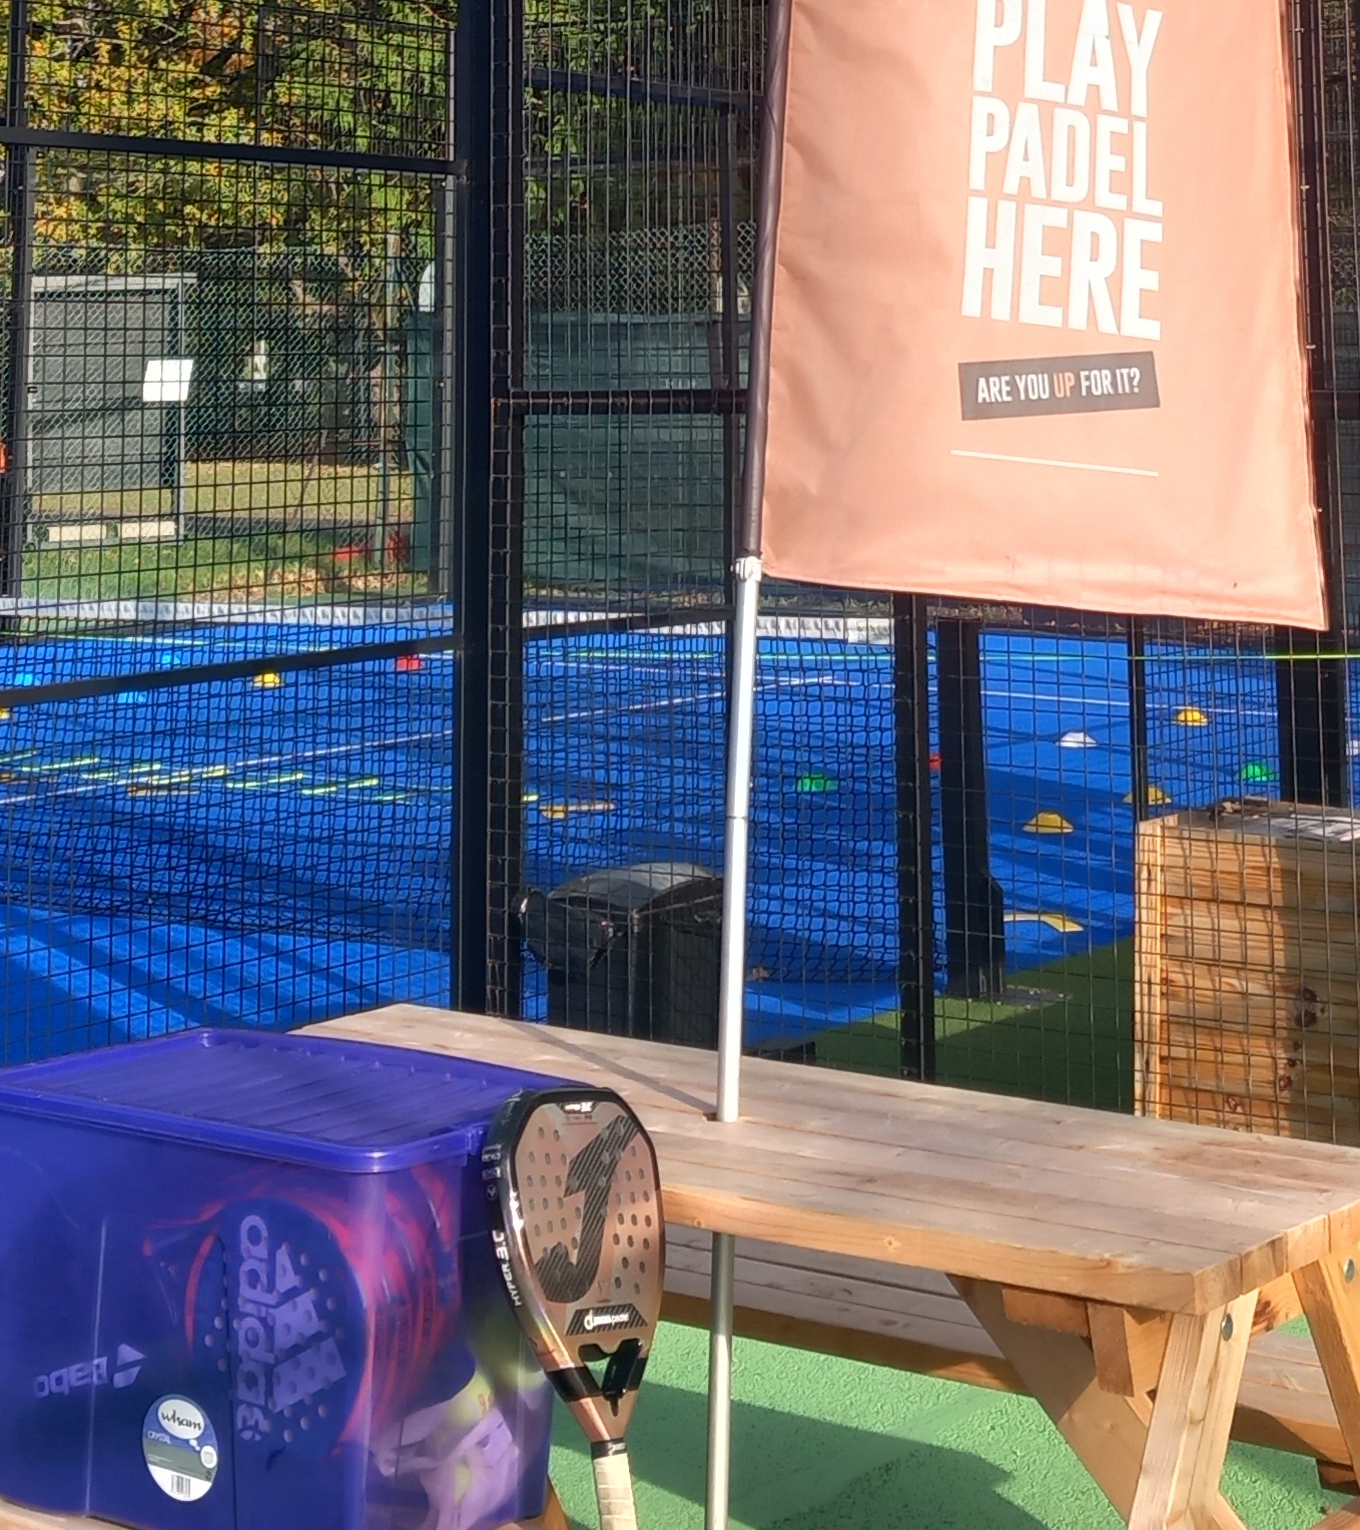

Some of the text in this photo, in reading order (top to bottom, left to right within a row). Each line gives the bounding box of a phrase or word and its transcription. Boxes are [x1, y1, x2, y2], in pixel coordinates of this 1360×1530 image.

[968, 95, 1164, 218] PADEL
[961, 195, 1164, 341] HERE
[977, 367, 1142, 404] ARE YOU UP FOR IT?
[501, 1263, 524, 1308] HYPER
